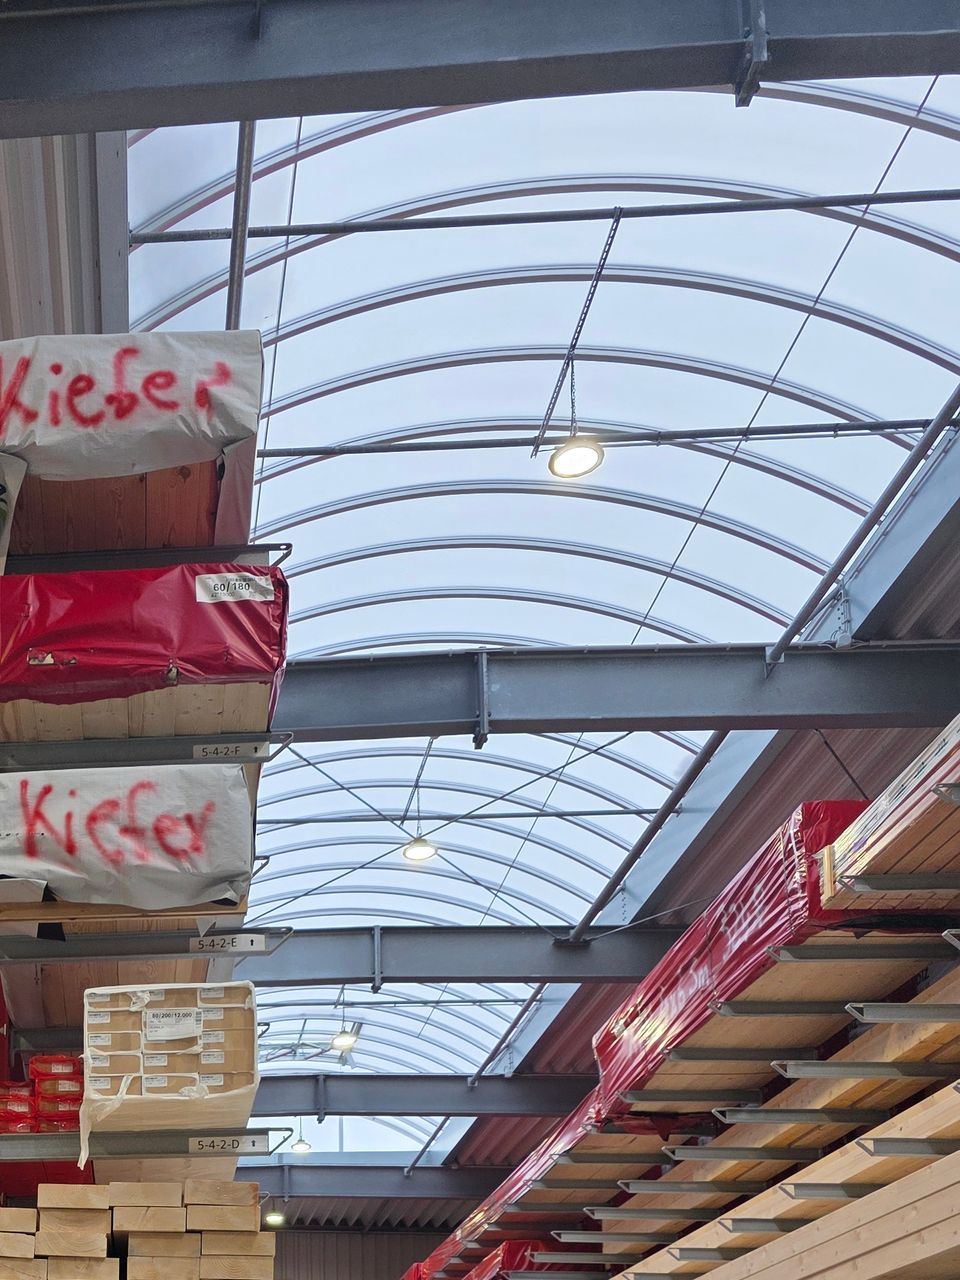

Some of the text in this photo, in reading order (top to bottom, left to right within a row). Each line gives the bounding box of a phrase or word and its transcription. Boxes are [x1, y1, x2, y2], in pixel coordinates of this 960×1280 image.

[213, 581, 251, 593] 60/180
[201, 745, 241, 758] 5-4-2-F
[19, 777, 217, 868] Kiefer
[197, 937, 238, 950] 5-4-2-E
[197, 1139, 240, 1151] 5-4-2-D
